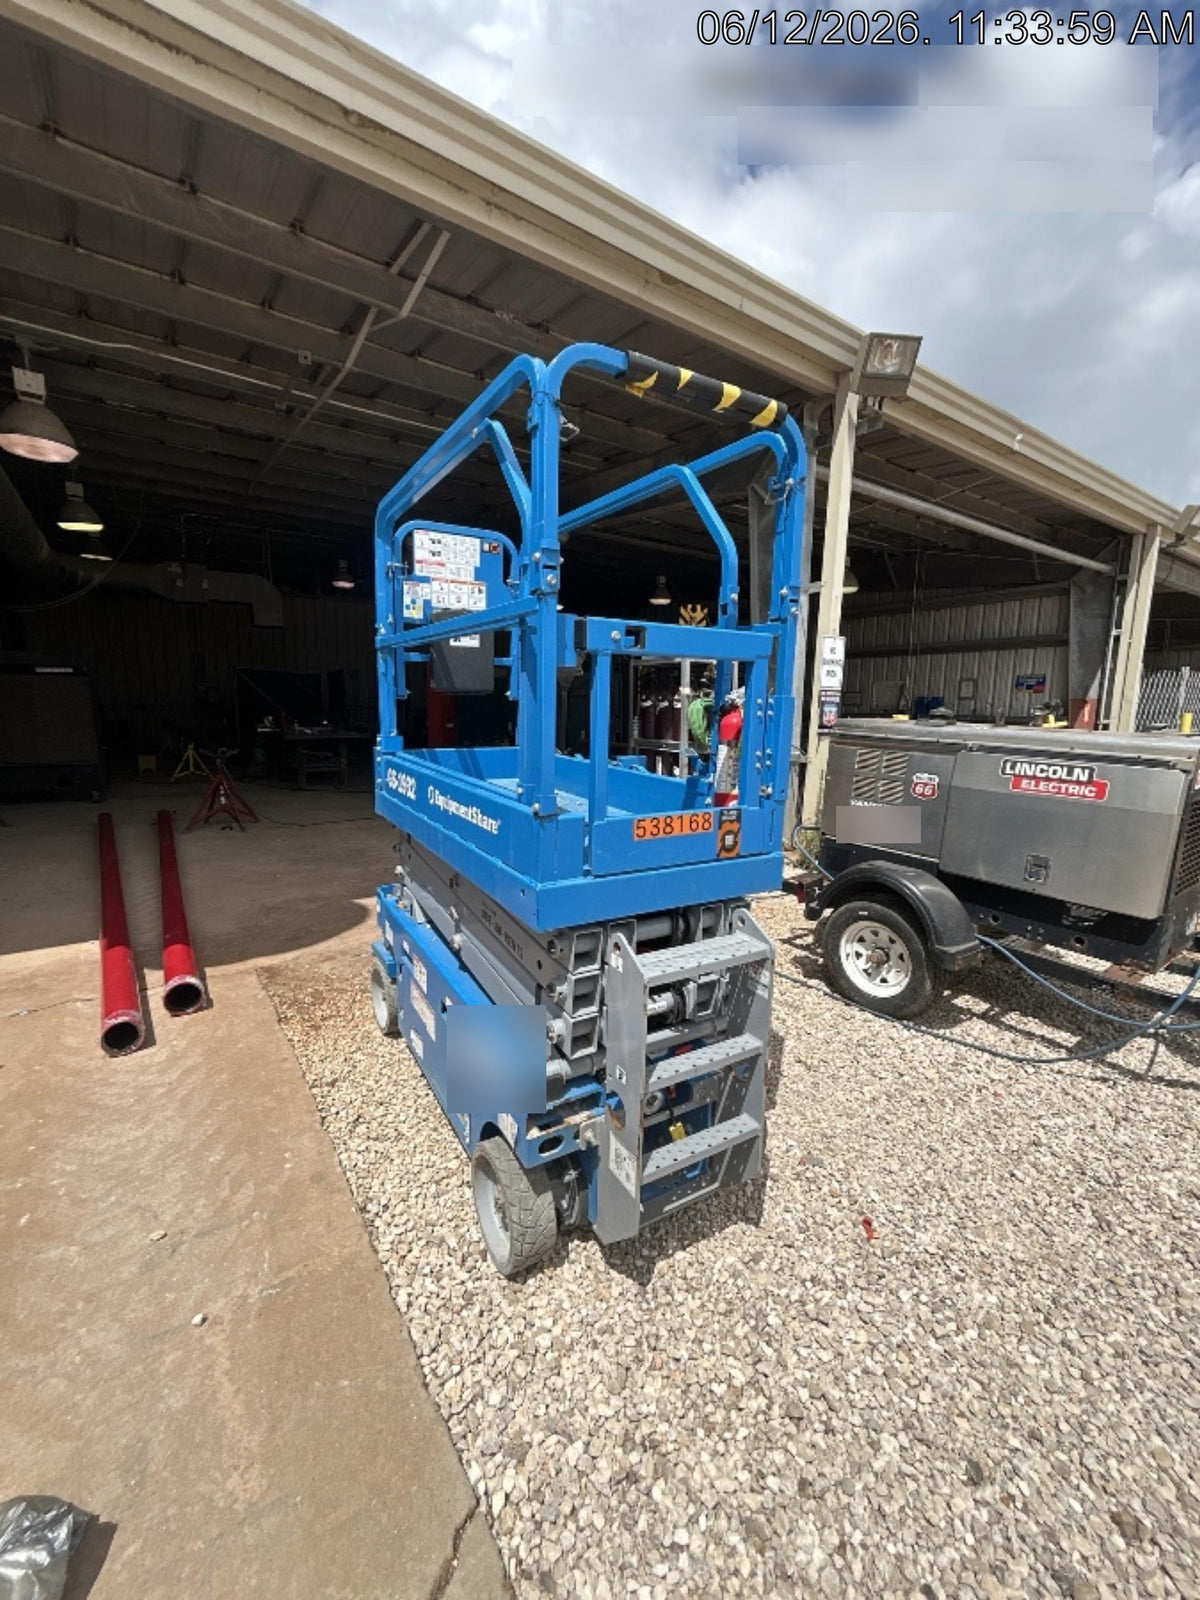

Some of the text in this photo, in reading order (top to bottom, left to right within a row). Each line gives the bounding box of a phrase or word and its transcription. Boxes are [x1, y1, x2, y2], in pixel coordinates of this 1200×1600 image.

[1004, 762, 1090, 782] LINCOLN
[915, 783, 934, 796] 66
[1020, 779, 1097, 797] ELECTRIC
[635, 812, 712, 839] 538168
